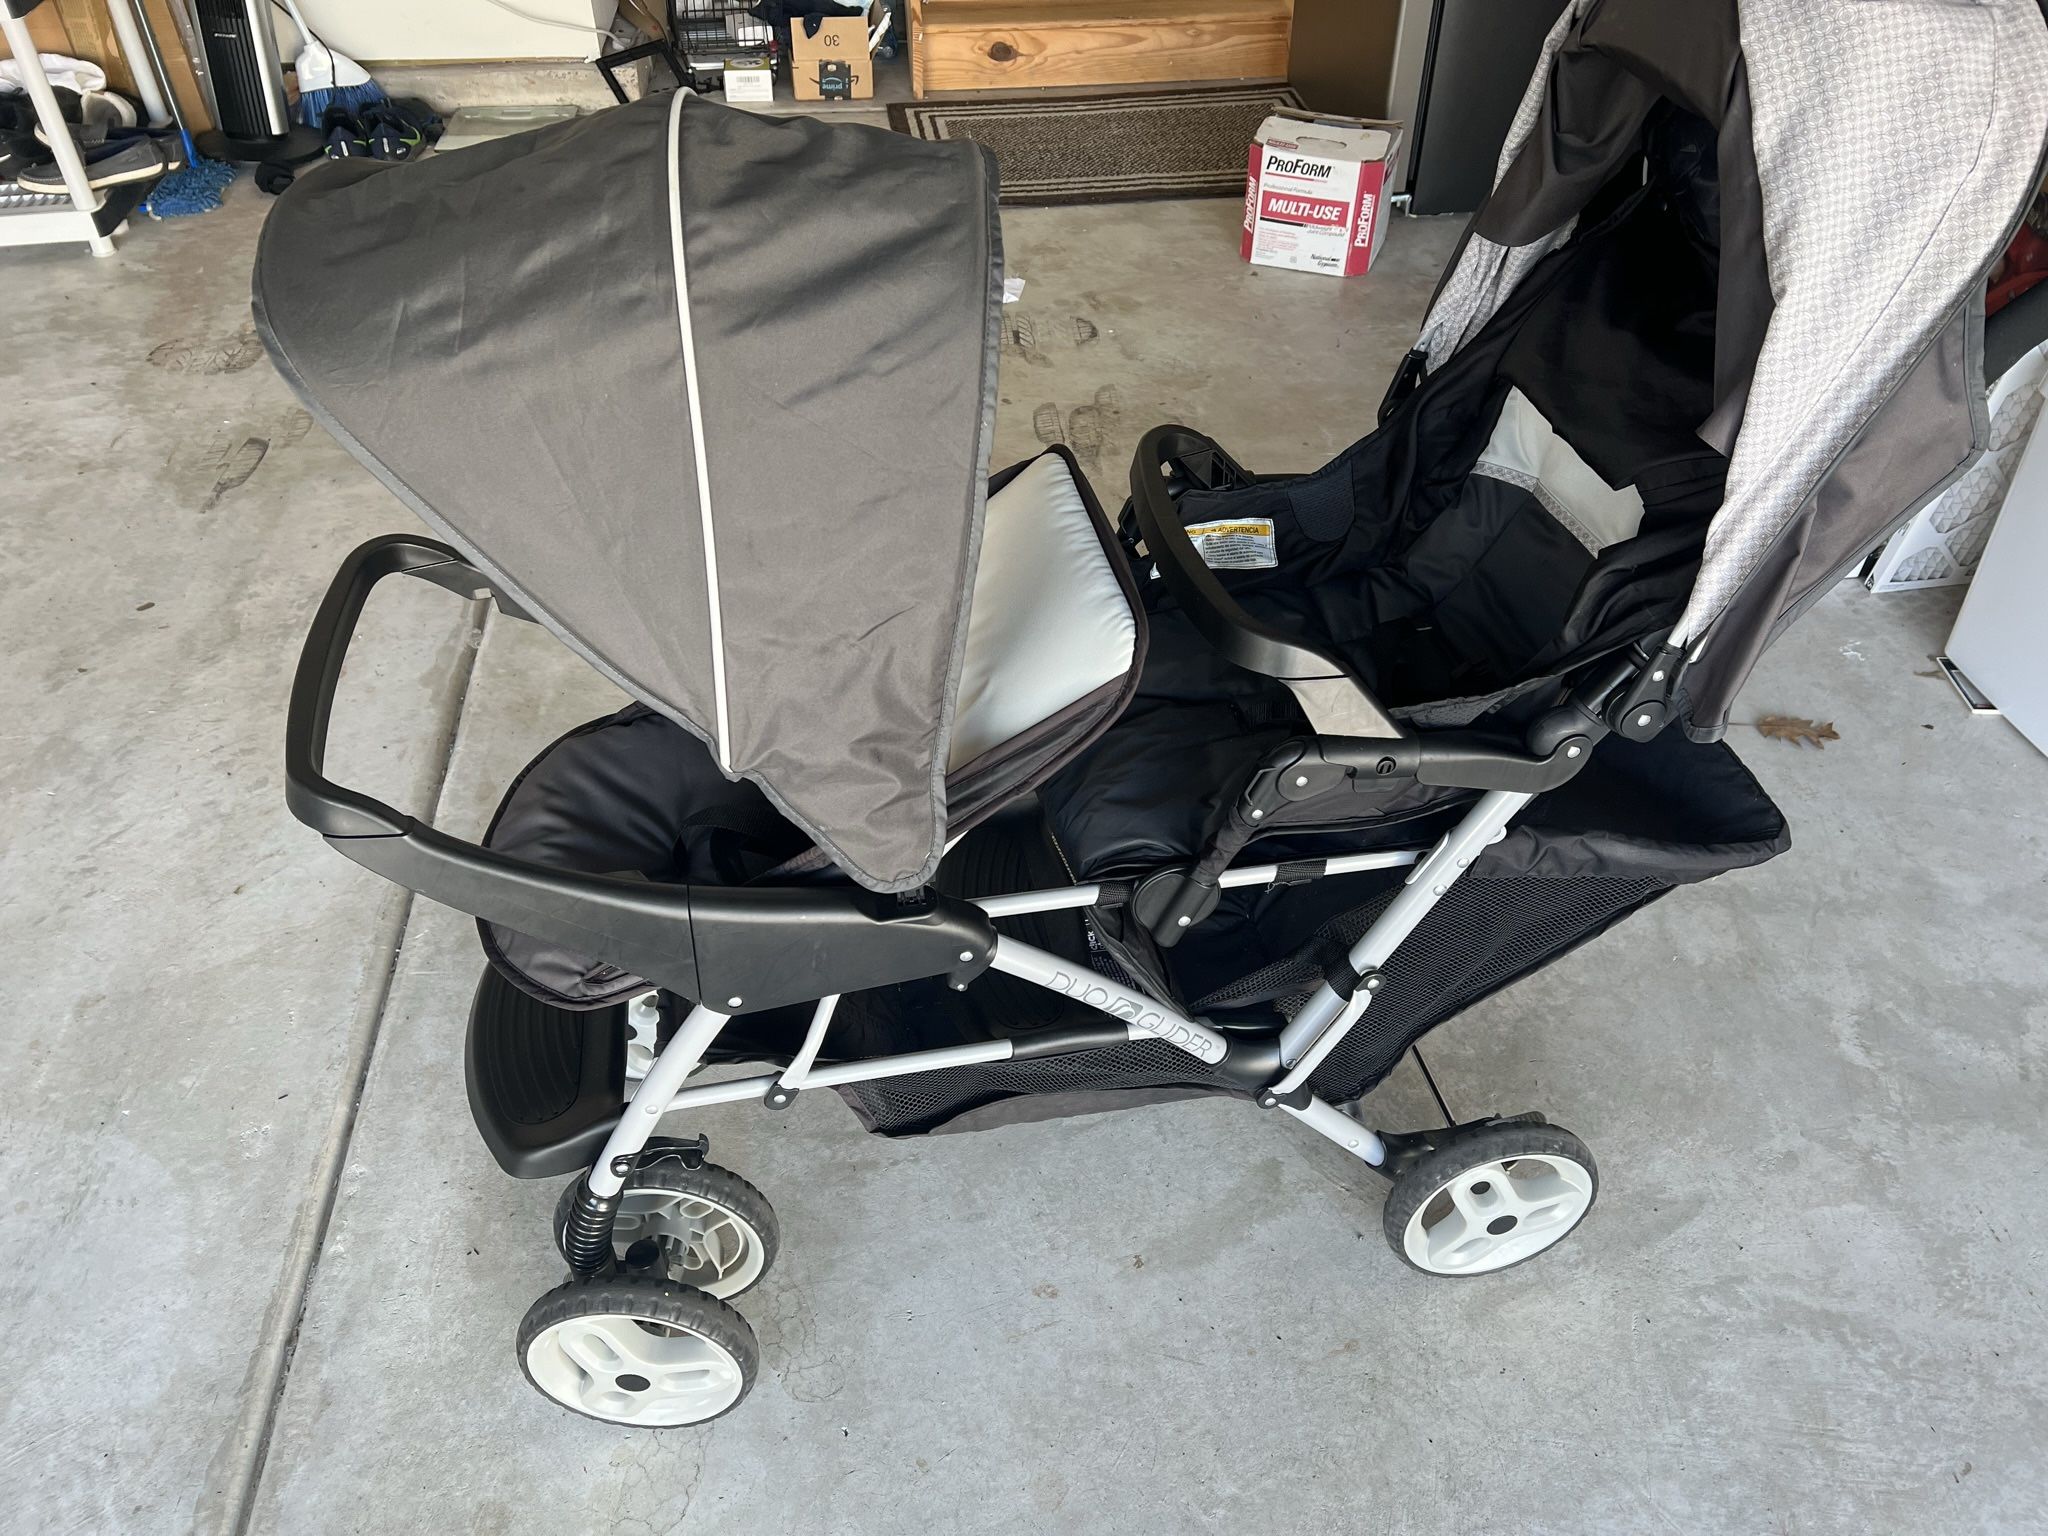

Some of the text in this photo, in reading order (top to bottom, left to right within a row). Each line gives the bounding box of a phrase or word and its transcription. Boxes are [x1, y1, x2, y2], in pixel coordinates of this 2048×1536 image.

[1267, 197, 1342, 221] MULTI-USE
[1218, 525, 1260, 534] ADVERTENCIA
[1046, 971, 1109, 1006] DUO
[1137, 1012, 1213, 1057] GLIDER
